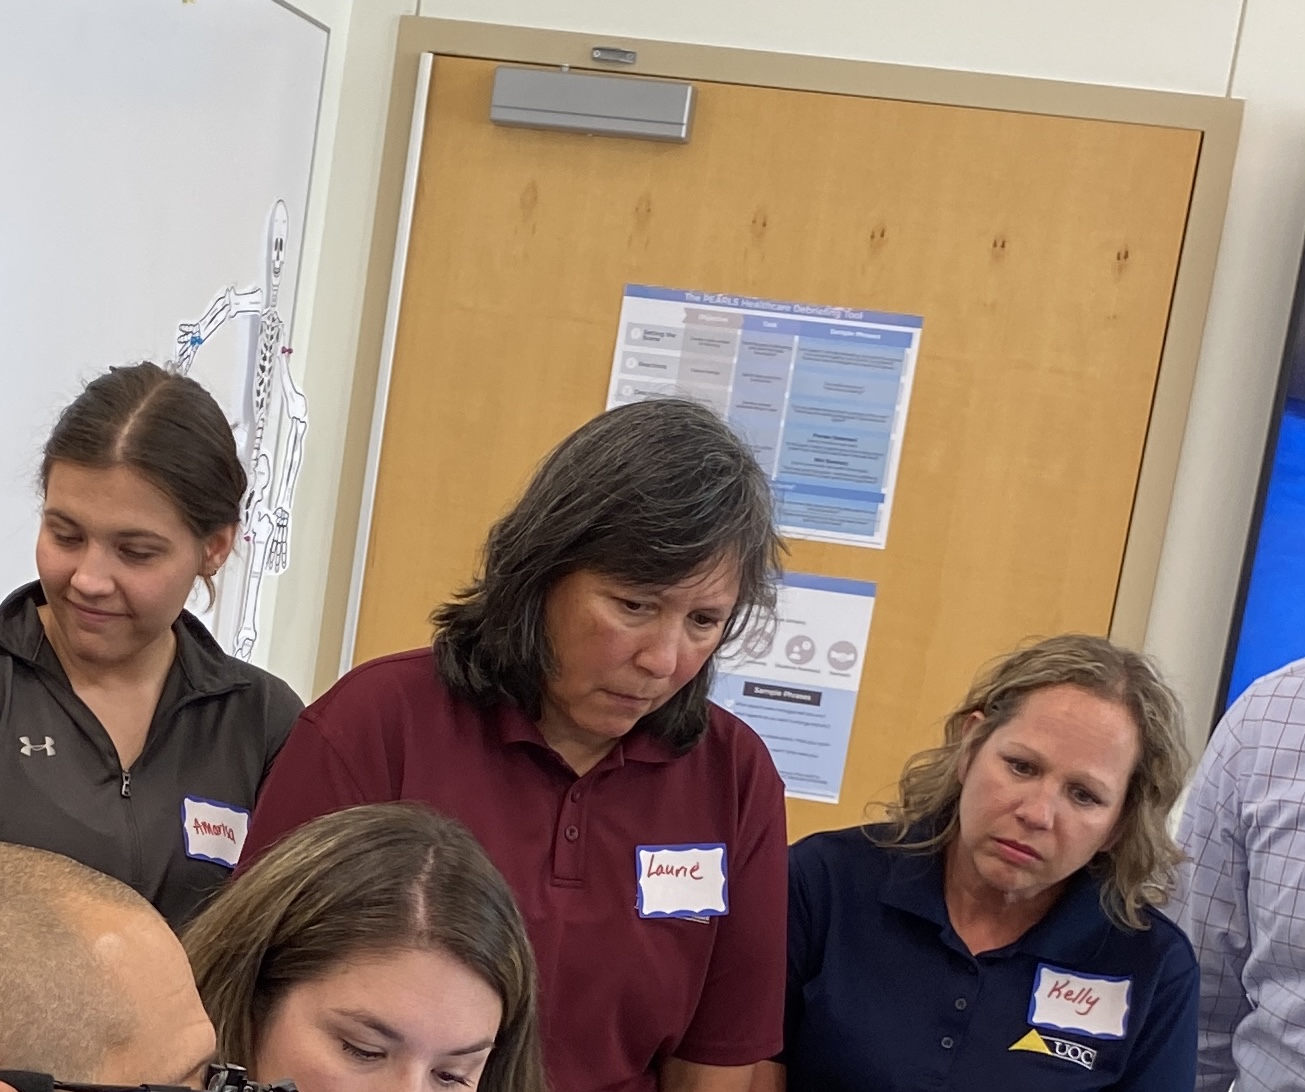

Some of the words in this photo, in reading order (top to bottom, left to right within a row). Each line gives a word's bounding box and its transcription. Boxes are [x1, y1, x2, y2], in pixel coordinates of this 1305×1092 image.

[646, 853, 704, 881] Laurie
[1047, 979, 1101, 1017] Kelly
[1054, 1041, 1094, 1065] UOC
